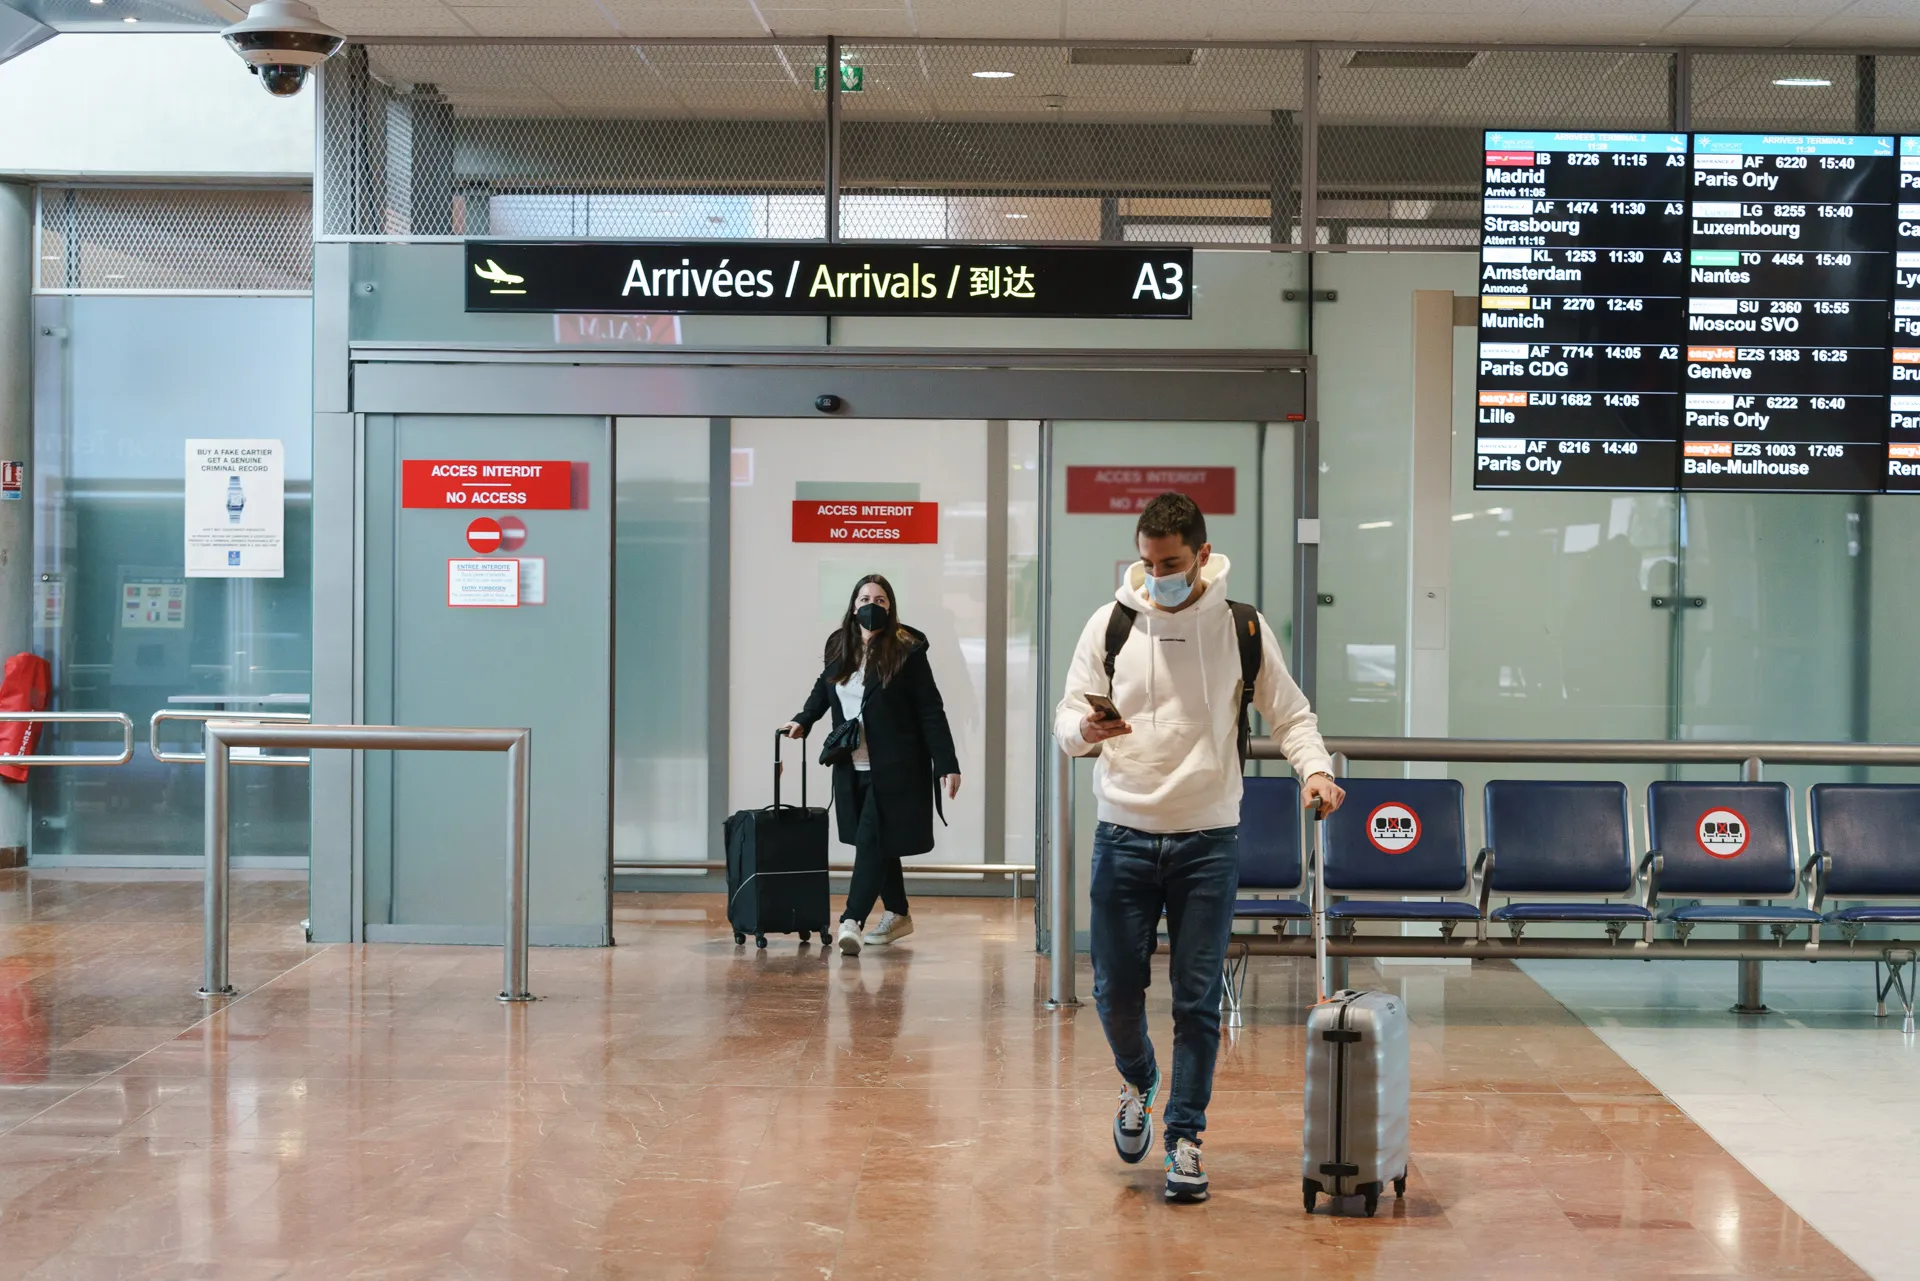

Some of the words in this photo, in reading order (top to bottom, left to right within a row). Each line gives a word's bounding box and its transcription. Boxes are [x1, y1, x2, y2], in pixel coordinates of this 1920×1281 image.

[1599, 134, 1637, 142] TERMINAL
[1762, 136, 1803, 145] ARRIVEES
[1806, 137, 1846, 145] TERMINAL
[1537, 153, 1551, 165] IB
[1568, 153, 1599, 165] 8726
[1612, 154, 1647, 166] 11:15
[1666, 155, 1685, 166] A3
[1744, 156, 1764, 168] AF
[1776, 157, 1807, 168] 6220
[1820, 157, 1855, 169] 15:40
[1486, 168, 1544, 183] Madrid
[1695, 171, 1738, 186] Paris
[1743, 172, 1779, 190] Orly
[1485, 187, 1516, 197] Arrivé
[1519, 188, 1545, 197] 11:05
[1535, 202, 1554, 213] AF
[1567, 202, 1598, 214] 1474
[1611, 202, 1645, 214] 11:30
[1664, 203, 1683, 215] A3
[1743, 205, 1762, 216] LG
[1774, 205, 1805, 217] 8255
[1818, 206, 1853, 217] 15:40
[1485, 217, 1579, 235] Strasbourg
[1693, 220, 1800, 239] Luxembourg
[1484, 236, 1516, 245] Atterri
[1518, 236, 1545, 245] 11:15
[1534, 250, 1553, 261] KL
[1565, 250, 1596, 262] 1253
[1609, 251, 1644, 263] 11:30
[1663, 251, 1681, 263] A3
[1741, 253, 1761, 264] TO
[1772, 254, 1804, 265] 4454
[1816, 254, 1851, 266] 15:40
[622, 259, 773, 297] Arrivées
[785, 261, 800, 297] /
[809, 263, 936, 298] Arrivals
[947, 265, 960, 298] /
[1483, 265, 1581, 280] Amsterdam
[1691, 268, 1750, 283] Nantes
[970, 266, 1035, 298] 到达
[1133, 263, 1183, 300] A3
[1482, 284, 1528, 293] Annoncé
[1532, 298, 1551, 309] LH
[1563, 298, 1594, 310] 2270
[1607, 299, 1642, 311] 12:45
[1739, 301, 1759, 313] SU
[1770, 301, 1802, 313] 2360
[1814, 302, 1849, 314] 15:55
[1482, 313, 1544, 328] Munich
[1690, 316, 1756, 331] Moscou
[1761, 317, 1798, 332] SVO
[1530, 346, 1550, 357] AF
[1562, 346, 1593, 358] 7714
[1606, 347, 1641, 359] 14:05
[1659, 347, 1678, 359] A2
[1688, 349, 1734, 360] easyJet
[1738, 349, 1765, 360] EZS
[1769, 349, 1800, 361] 1383
[1812, 350, 1847, 362] 16:25
[1481, 361, 1524, 376] Paris
[1529, 361, 1568, 376] CDG
[1688, 364, 1751, 379] Genève
[1480, 393, 1526, 404] easyJet
[1530, 394, 1556, 405] EJU
[1561, 394, 1591, 406] 1682
[1604, 394, 1639, 406] 14:05
[1735, 397, 1755, 408] AF
[1767, 397, 1798, 409] 6222
[1810, 398, 1845, 409] 16:40
[1480, 409, 1515, 423] Lille
[1686, 412, 1729, 426] Paris
[1734, 412, 1769, 430] Orly
[1891, 413, 1920, 428] Par
[1527, 441, 1547, 452] AF
[1559, 441, 1590, 453] 6216
[1602, 442, 1637, 454] 14:40
[1685, 445, 1731, 456] easyJet
[1734, 444, 1761, 456] EZS
[1765, 444, 1796, 456] 1003
[1808, 445, 1843, 457] 17:05
[431, 465, 477, 477] ACCES
[482, 466, 542, 477] INTERDIT
[1478, 456, 1521, 471] Paris
[1526, 457, 1561, 475] Orly
[1684, 459, 1809, 475] Bale-Mulhouse
[1095, 471, 1142, 483] ACCES
[1146, 471, 1208, 484] INTERDIT
[446, 492, 466, 503] NO
[471, 492, 527, 504] ACCESS
[1110, 497, 1132, 510] NO
[817, 505, 857, 516] ACCES
[861, 506, 914, 516] INTERDIT
[830, 528, 848, 538] NO
[852, 528, 900, 539] ACCESS
